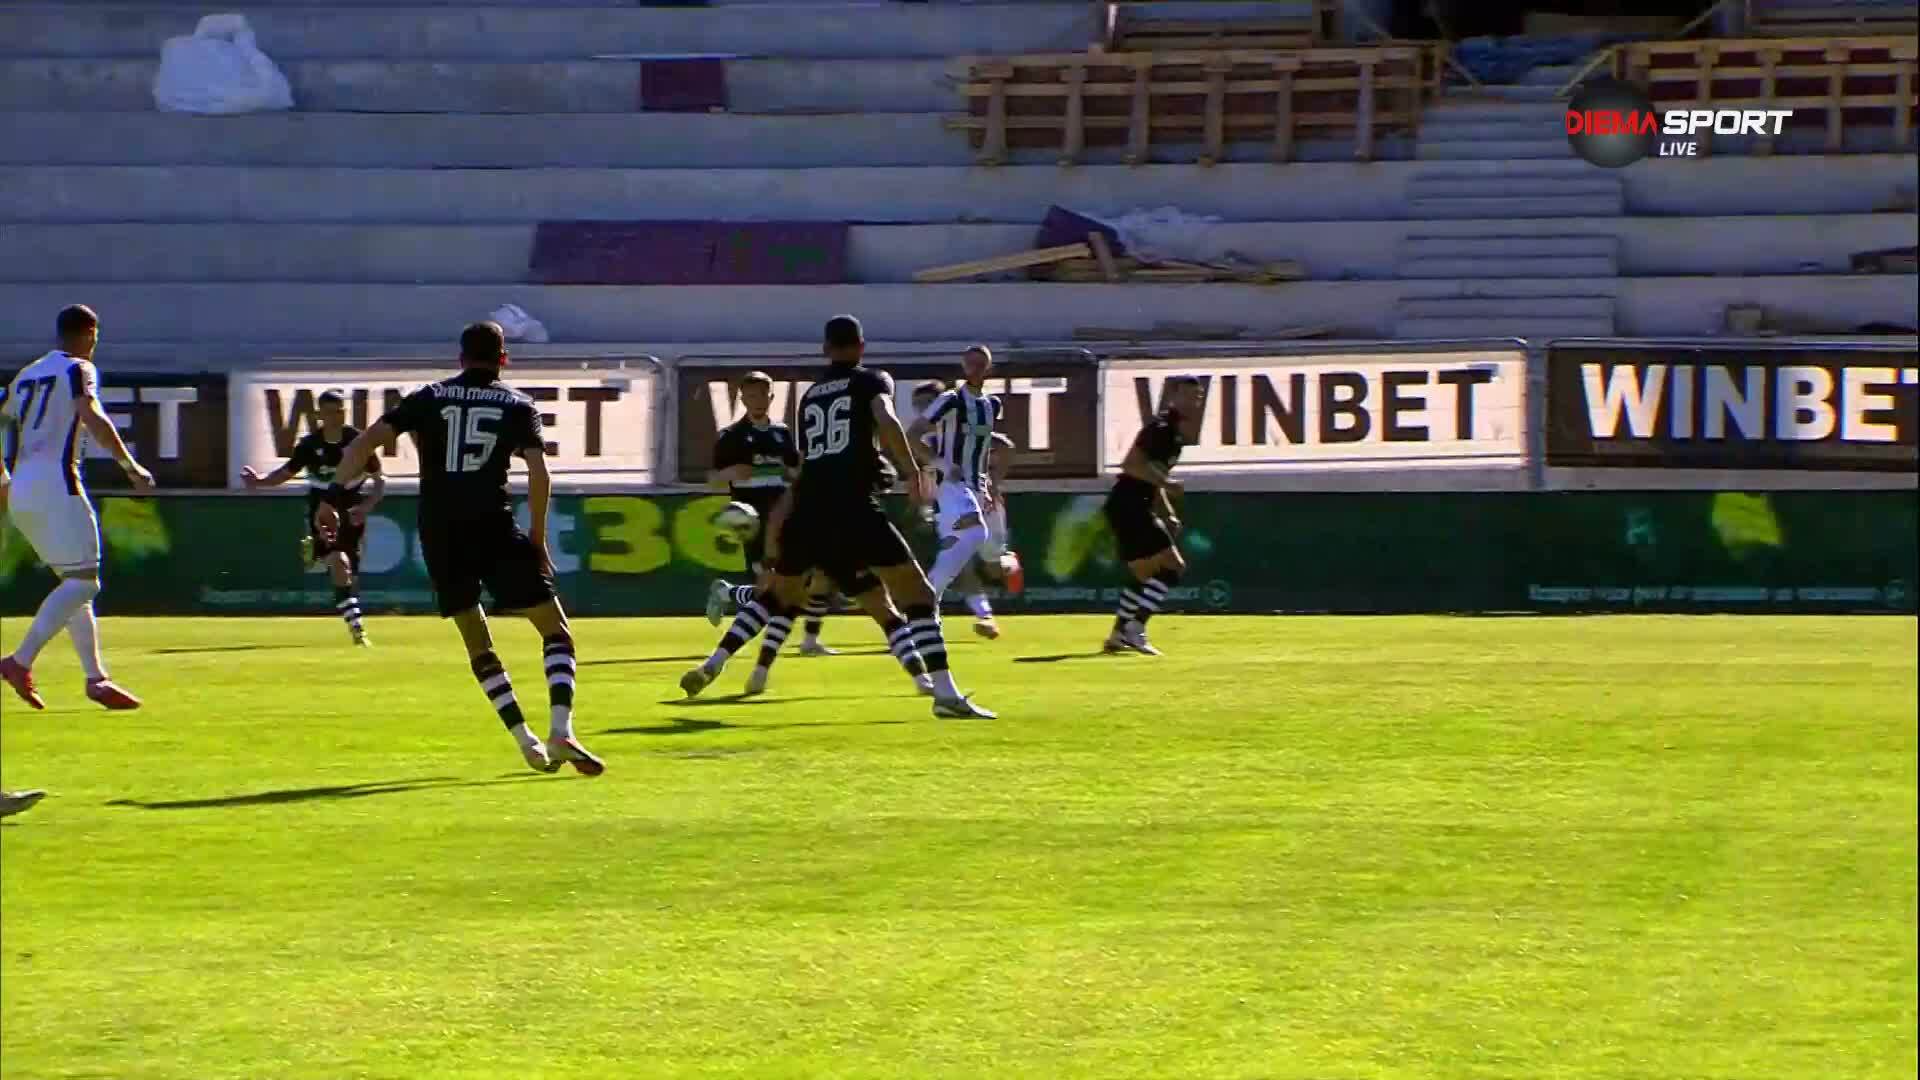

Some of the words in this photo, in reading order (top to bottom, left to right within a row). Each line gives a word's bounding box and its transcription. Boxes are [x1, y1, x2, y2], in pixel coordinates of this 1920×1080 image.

[16, 375, 57, 430] 77
[803, 395, 852, 461] 26
[1133, 368, 1499, 446] WINBET
[1581, 361, 1918, 443] WINBE
[439, 404, 505, 473] 15
